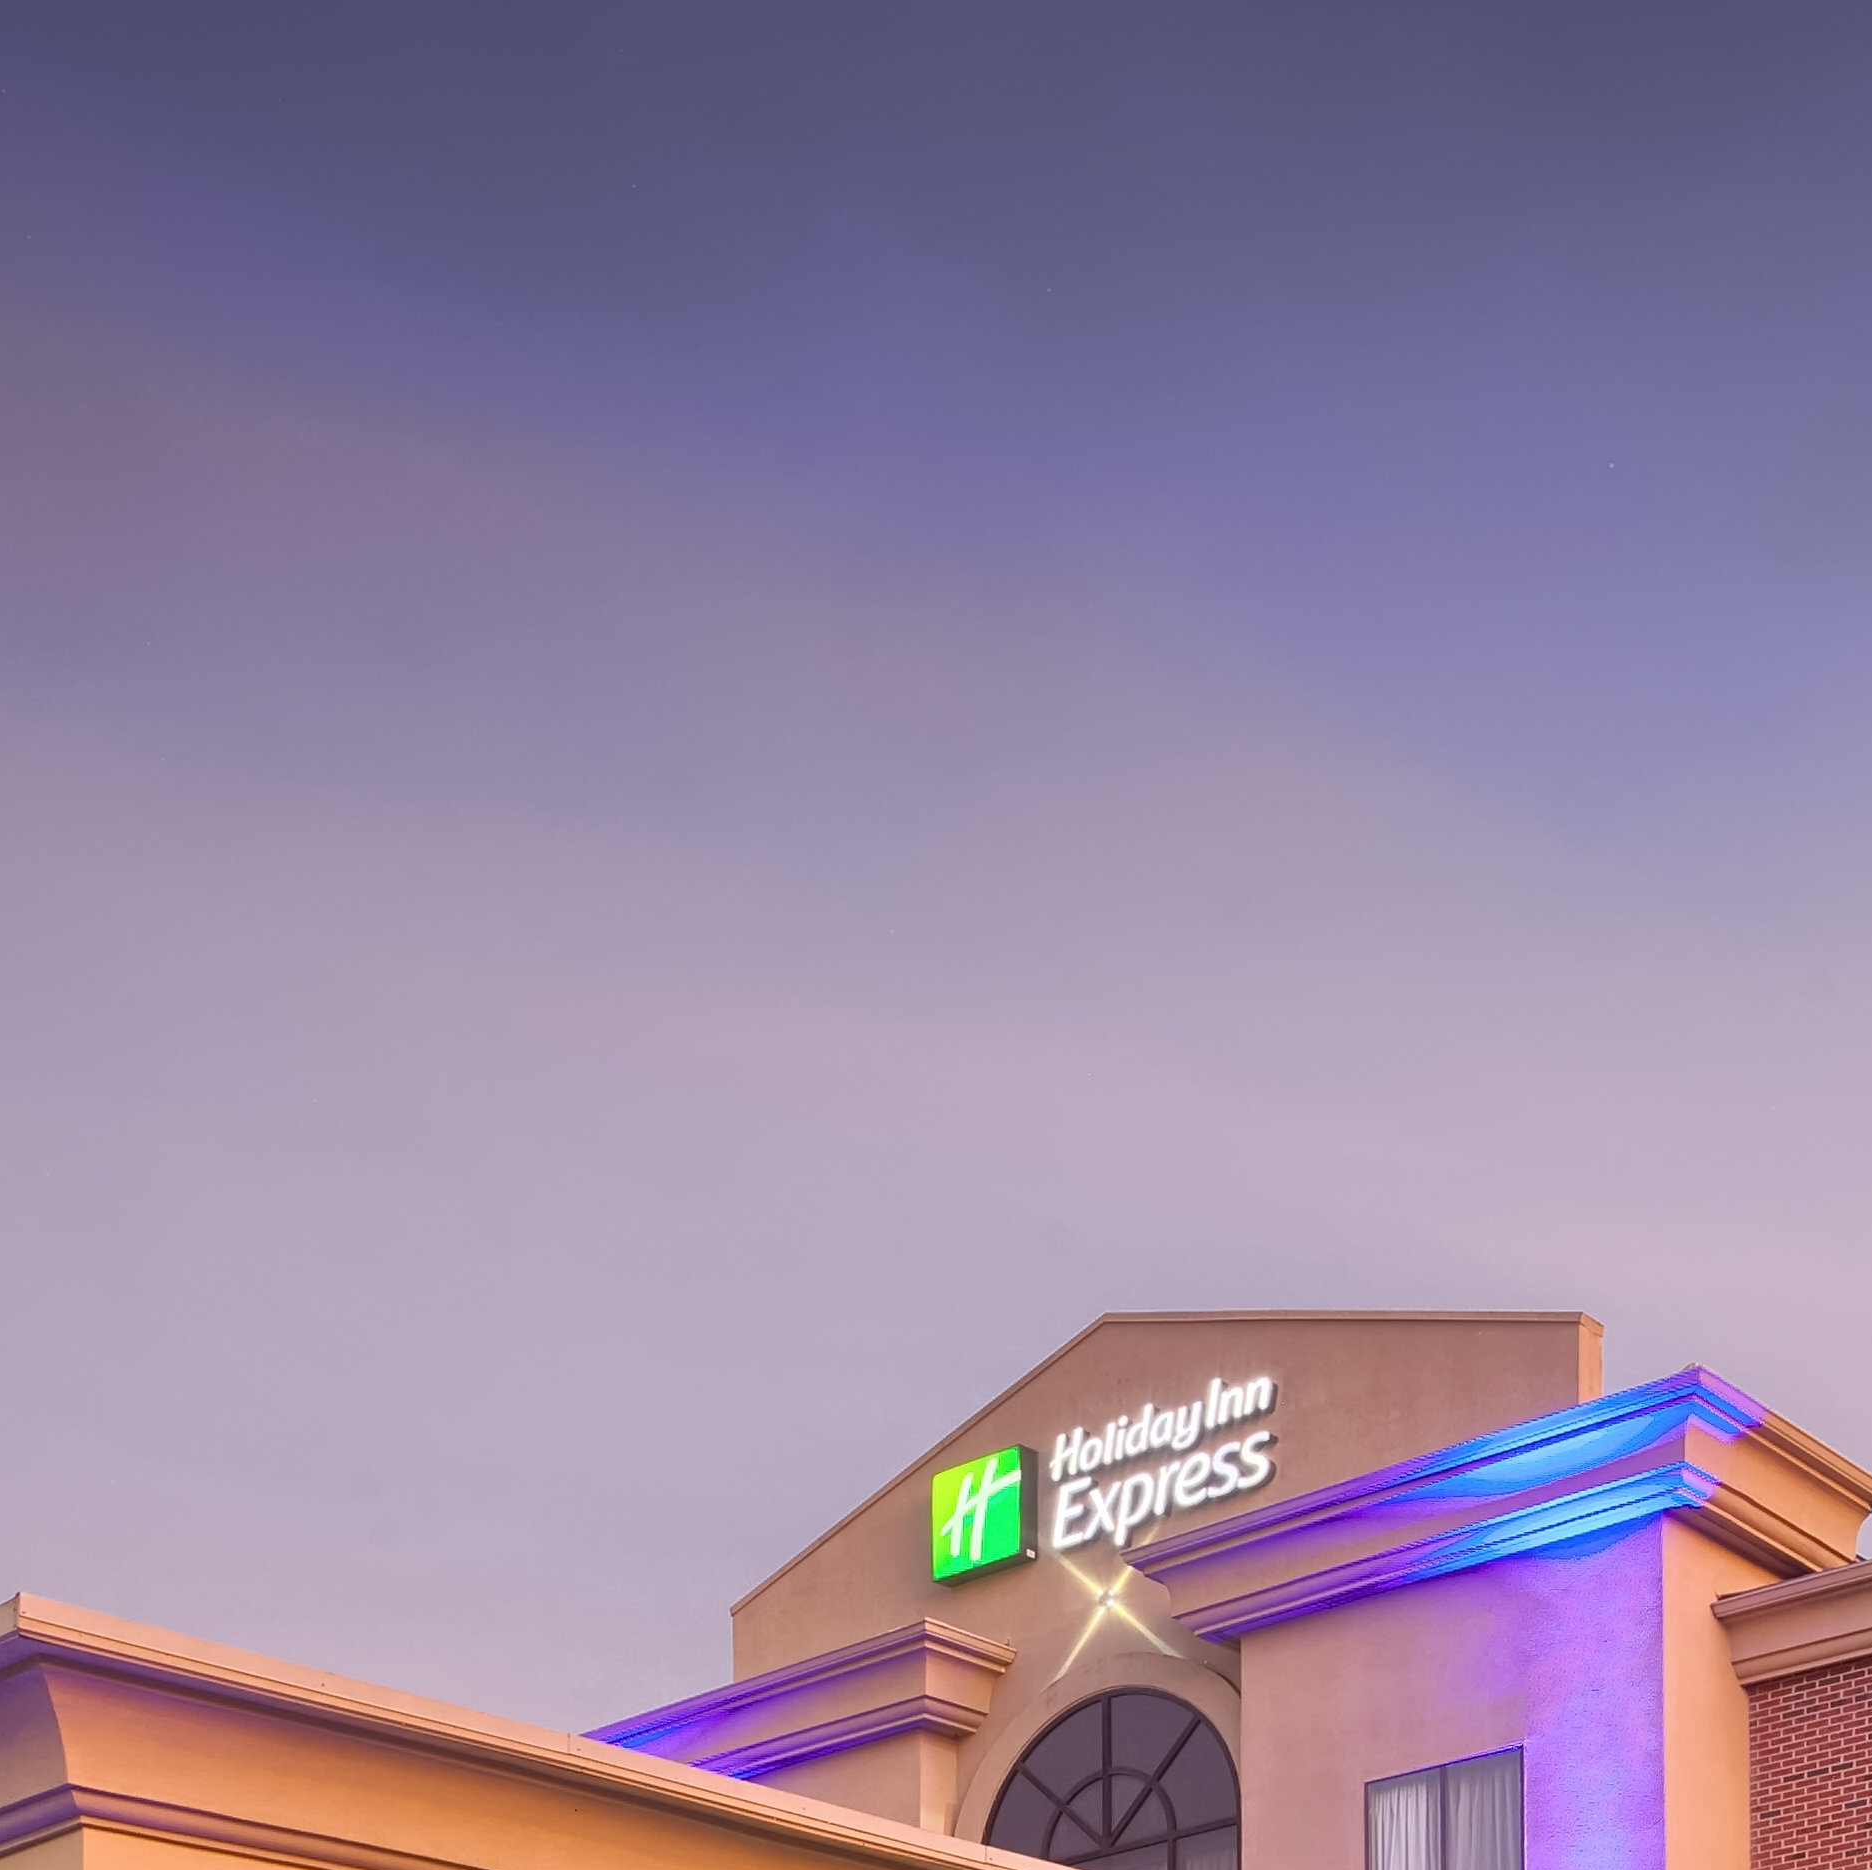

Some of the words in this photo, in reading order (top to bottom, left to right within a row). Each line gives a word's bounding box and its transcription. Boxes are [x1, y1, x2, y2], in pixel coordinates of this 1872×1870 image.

[1049, 1401, 1203, 1482] Holiday
[1205, 1377, 1272, 1430] Inn
[1051, 1430, 1272, 1550] Express
